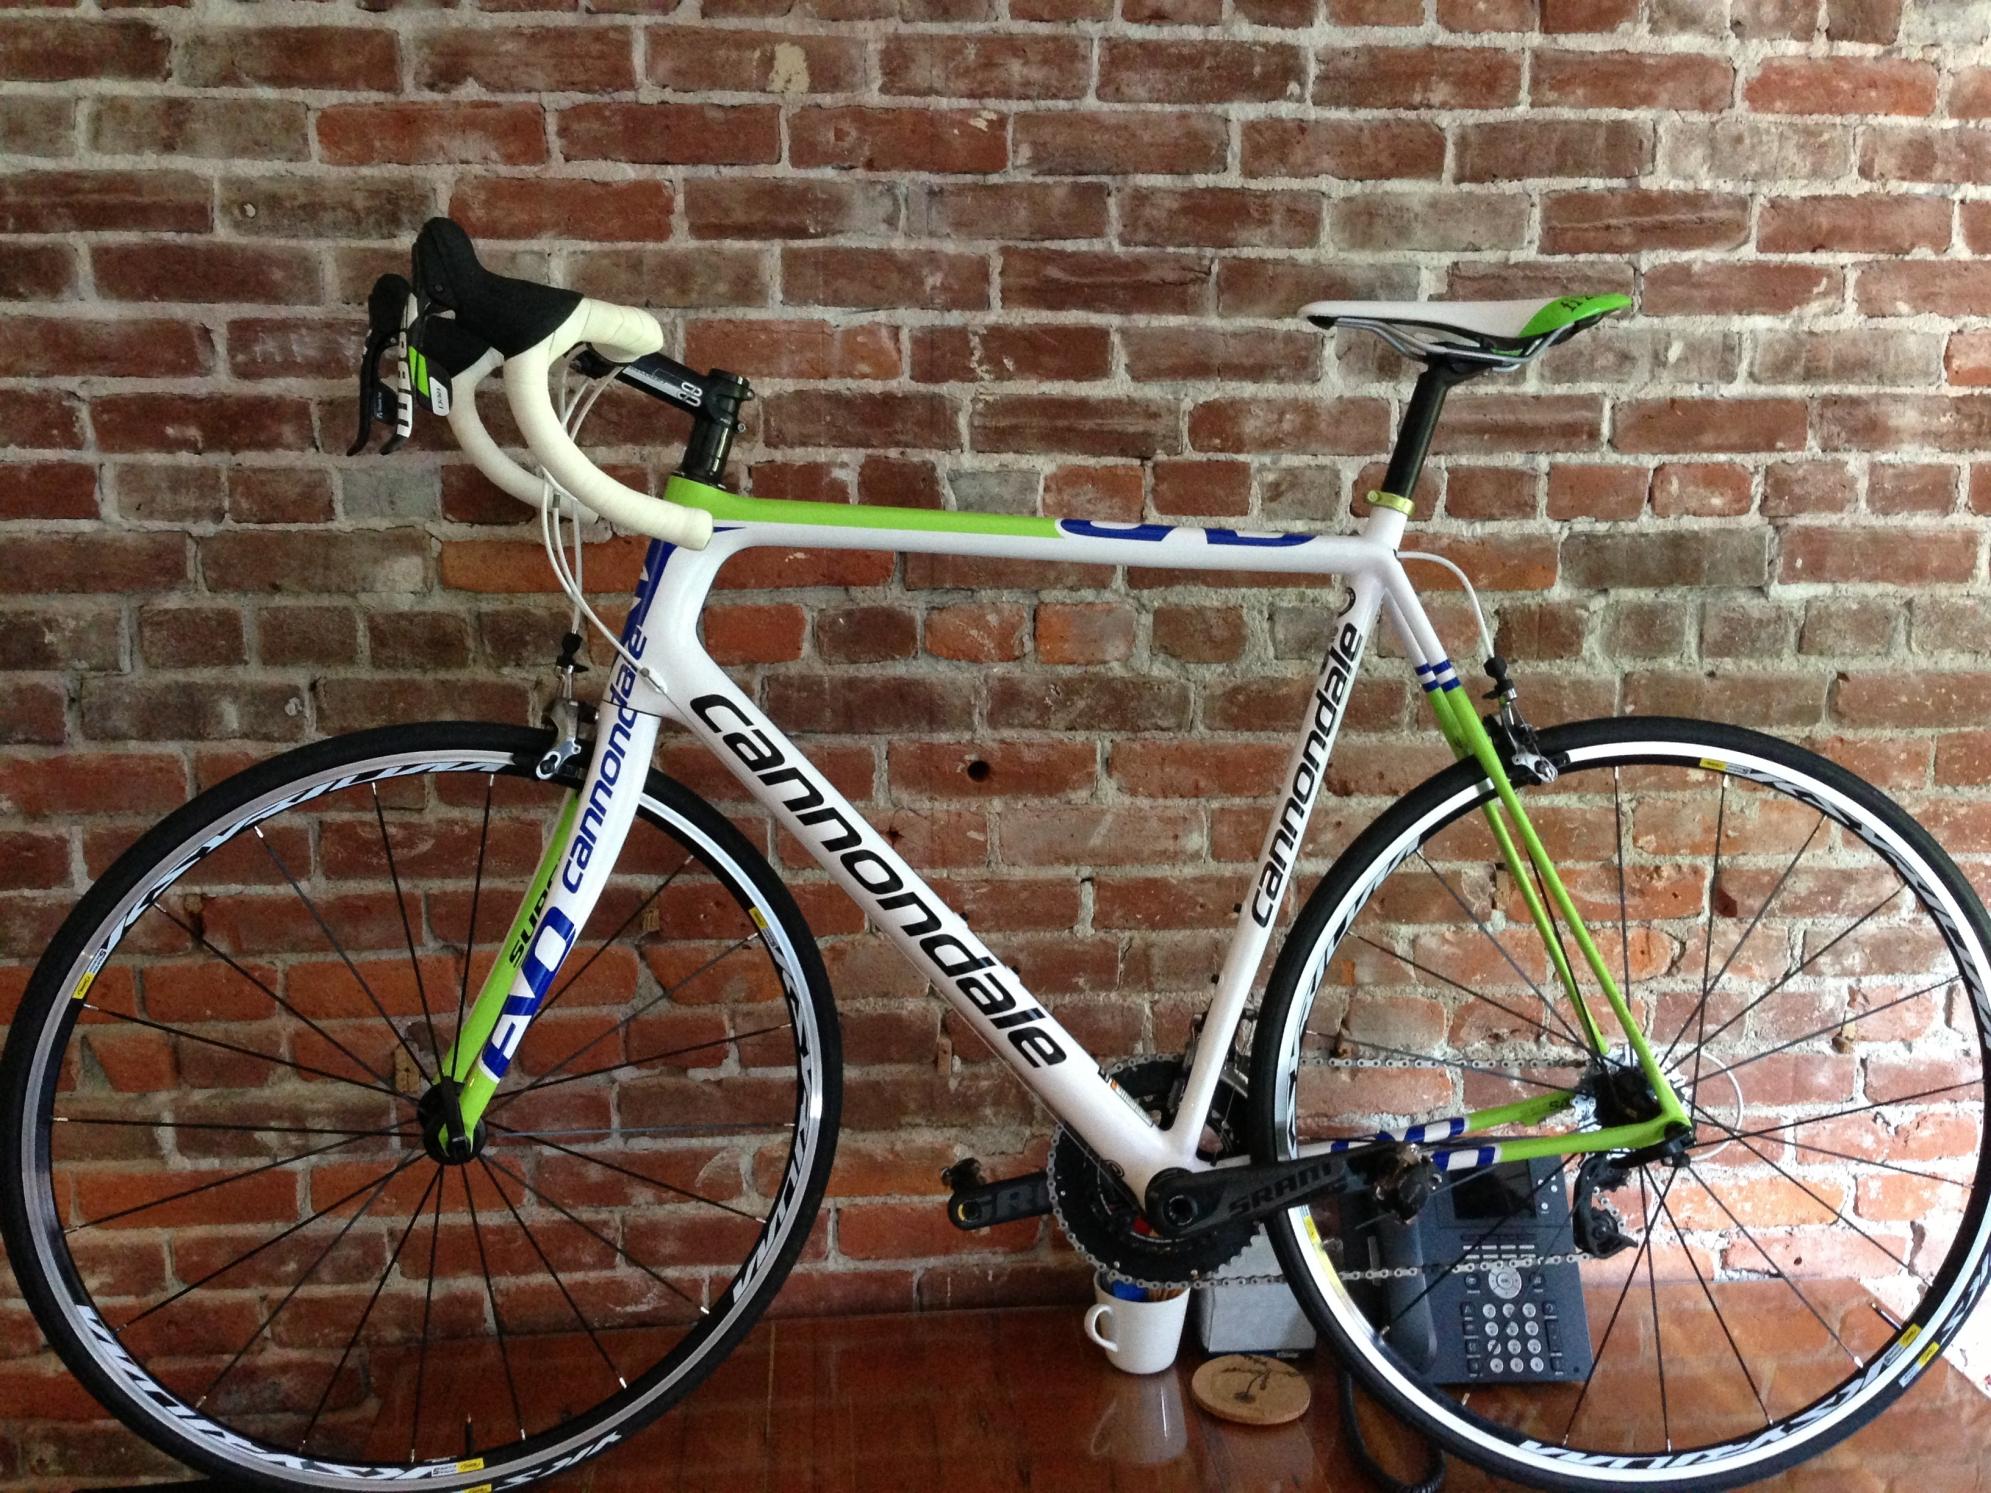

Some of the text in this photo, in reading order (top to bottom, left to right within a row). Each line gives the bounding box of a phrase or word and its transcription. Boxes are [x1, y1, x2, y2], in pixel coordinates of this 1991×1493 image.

[563, 626, 648, 894] cannondale
[690, 694, 1067, 1069] cannondale
[1252, 622, 1362, 928] cannondale
[482, 906, 576, 1078] EVO
